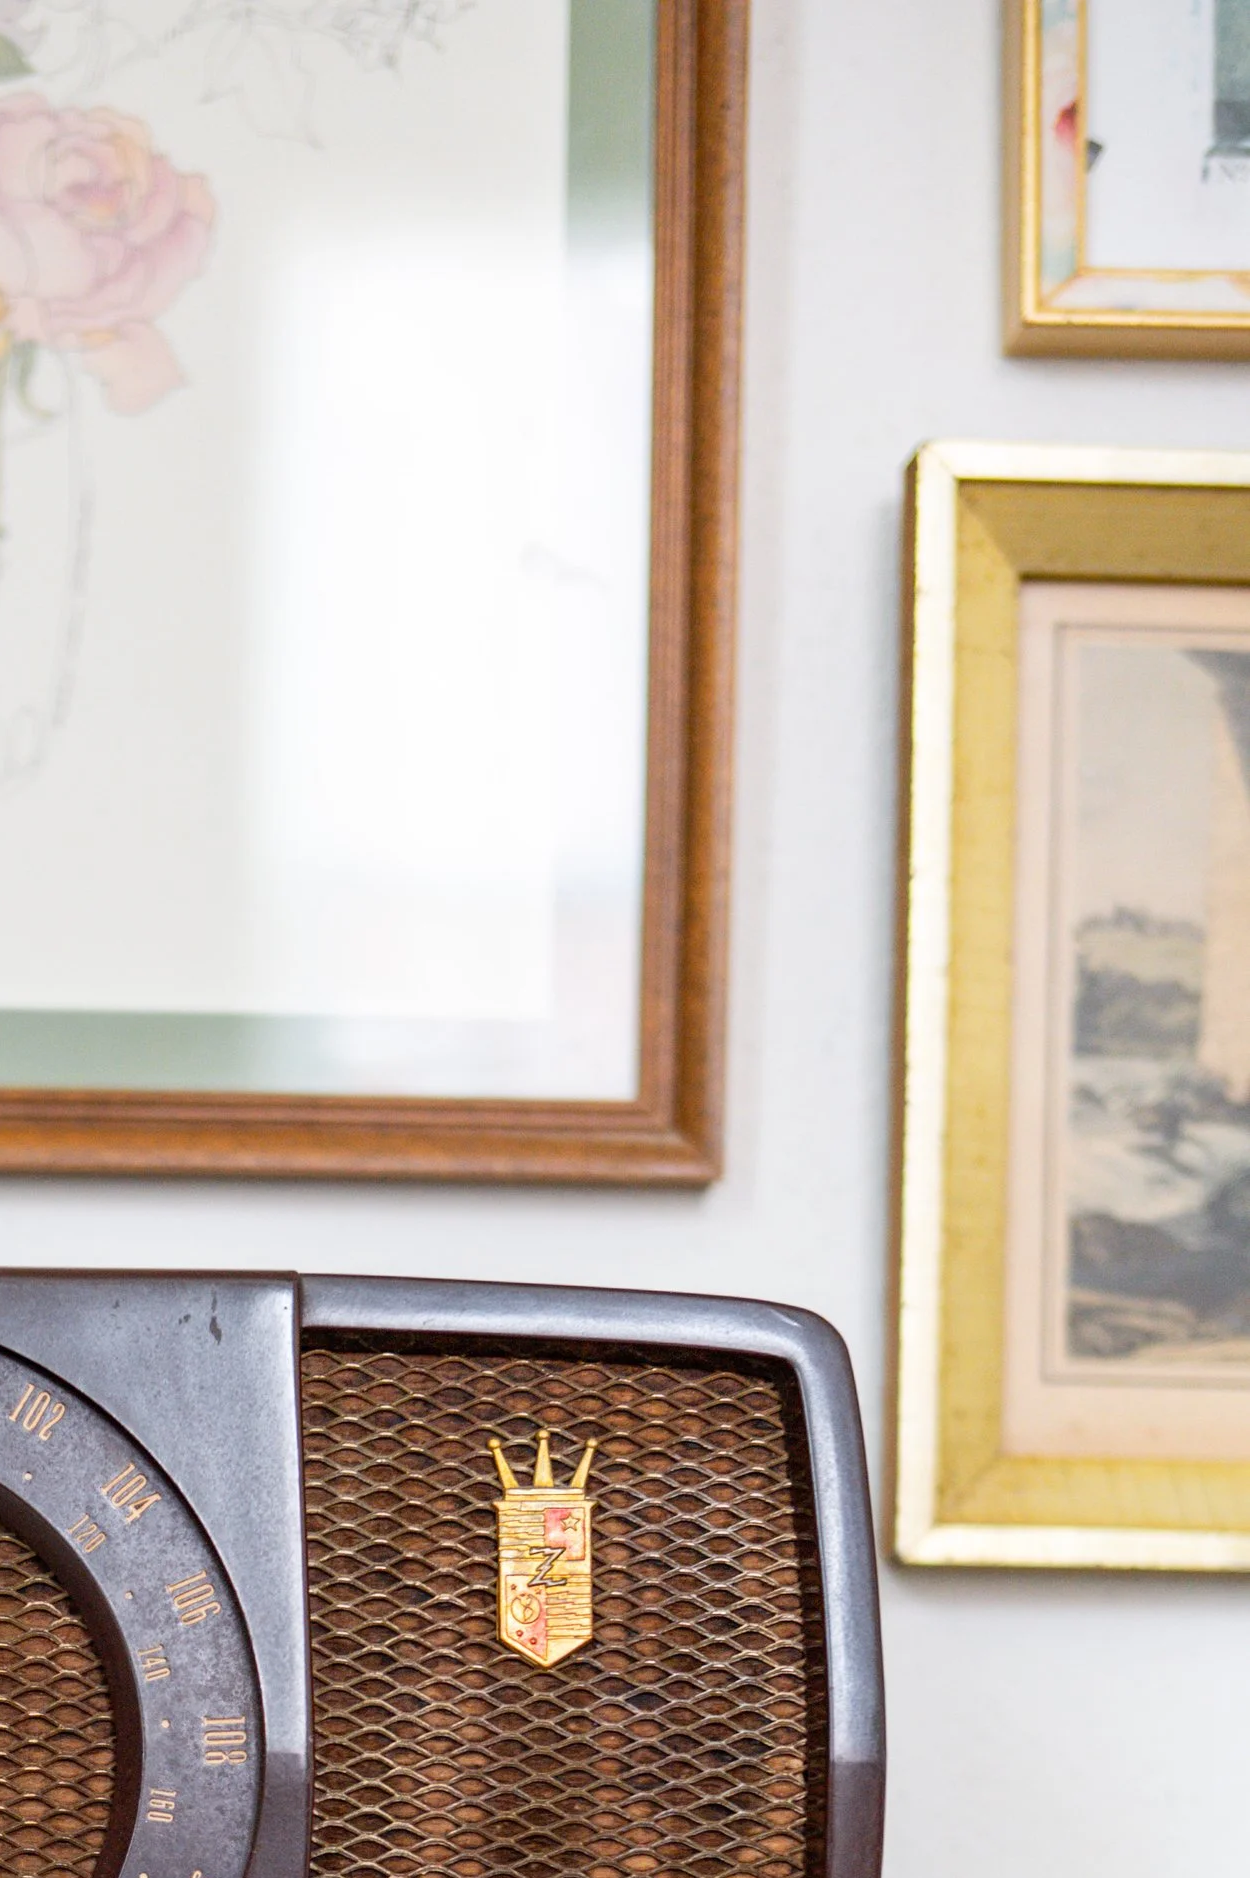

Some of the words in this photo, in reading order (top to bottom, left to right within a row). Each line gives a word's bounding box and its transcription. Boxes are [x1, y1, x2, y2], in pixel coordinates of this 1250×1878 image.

[68, 1514, 107, 1554] 120
[7, 1382, 68, 1441] 102
[100, 1462, 162, 1525] 104
[165, 1569, 221, 1627] 106
[202, 1716, 248, 1767] 108
[136, 1645, 173, 1683] 140
[146, 1787, 177, 1824] 160
